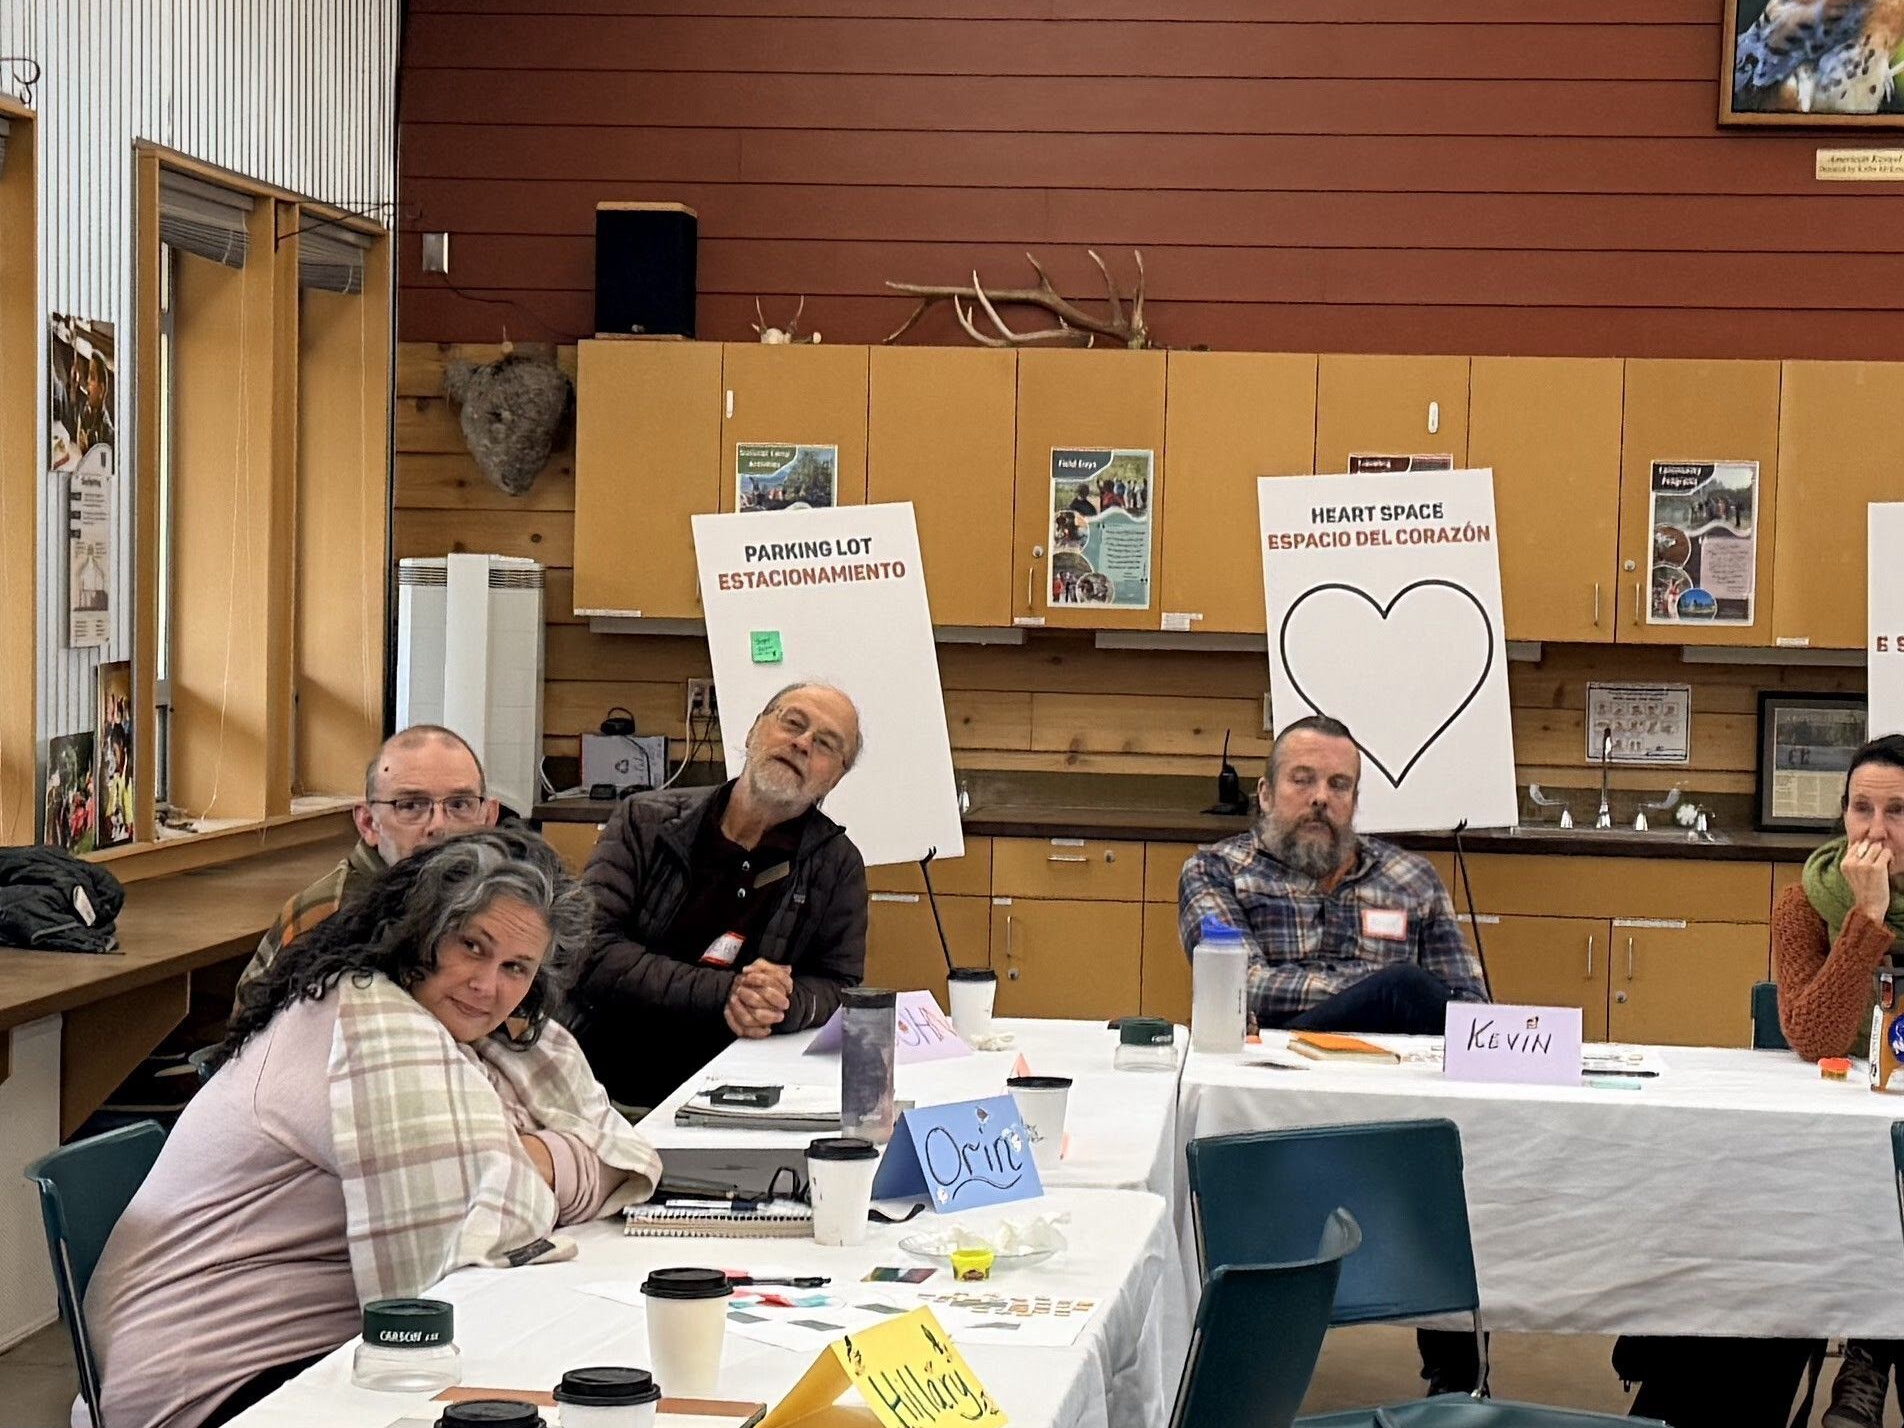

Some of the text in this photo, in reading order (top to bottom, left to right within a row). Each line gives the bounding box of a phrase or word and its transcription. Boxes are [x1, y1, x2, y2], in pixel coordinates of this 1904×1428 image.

[1311, 501, 1444, 524] HEART SPACE
[744, 537, 873, 563] PARKING LOT
[1268, 521, 1490, 551] ESPACIO DEL CORAZÓN
[718, 560, 906, 591] ESTACIONAMIENTO
[925, 1126, 1023, 1187] Orin
